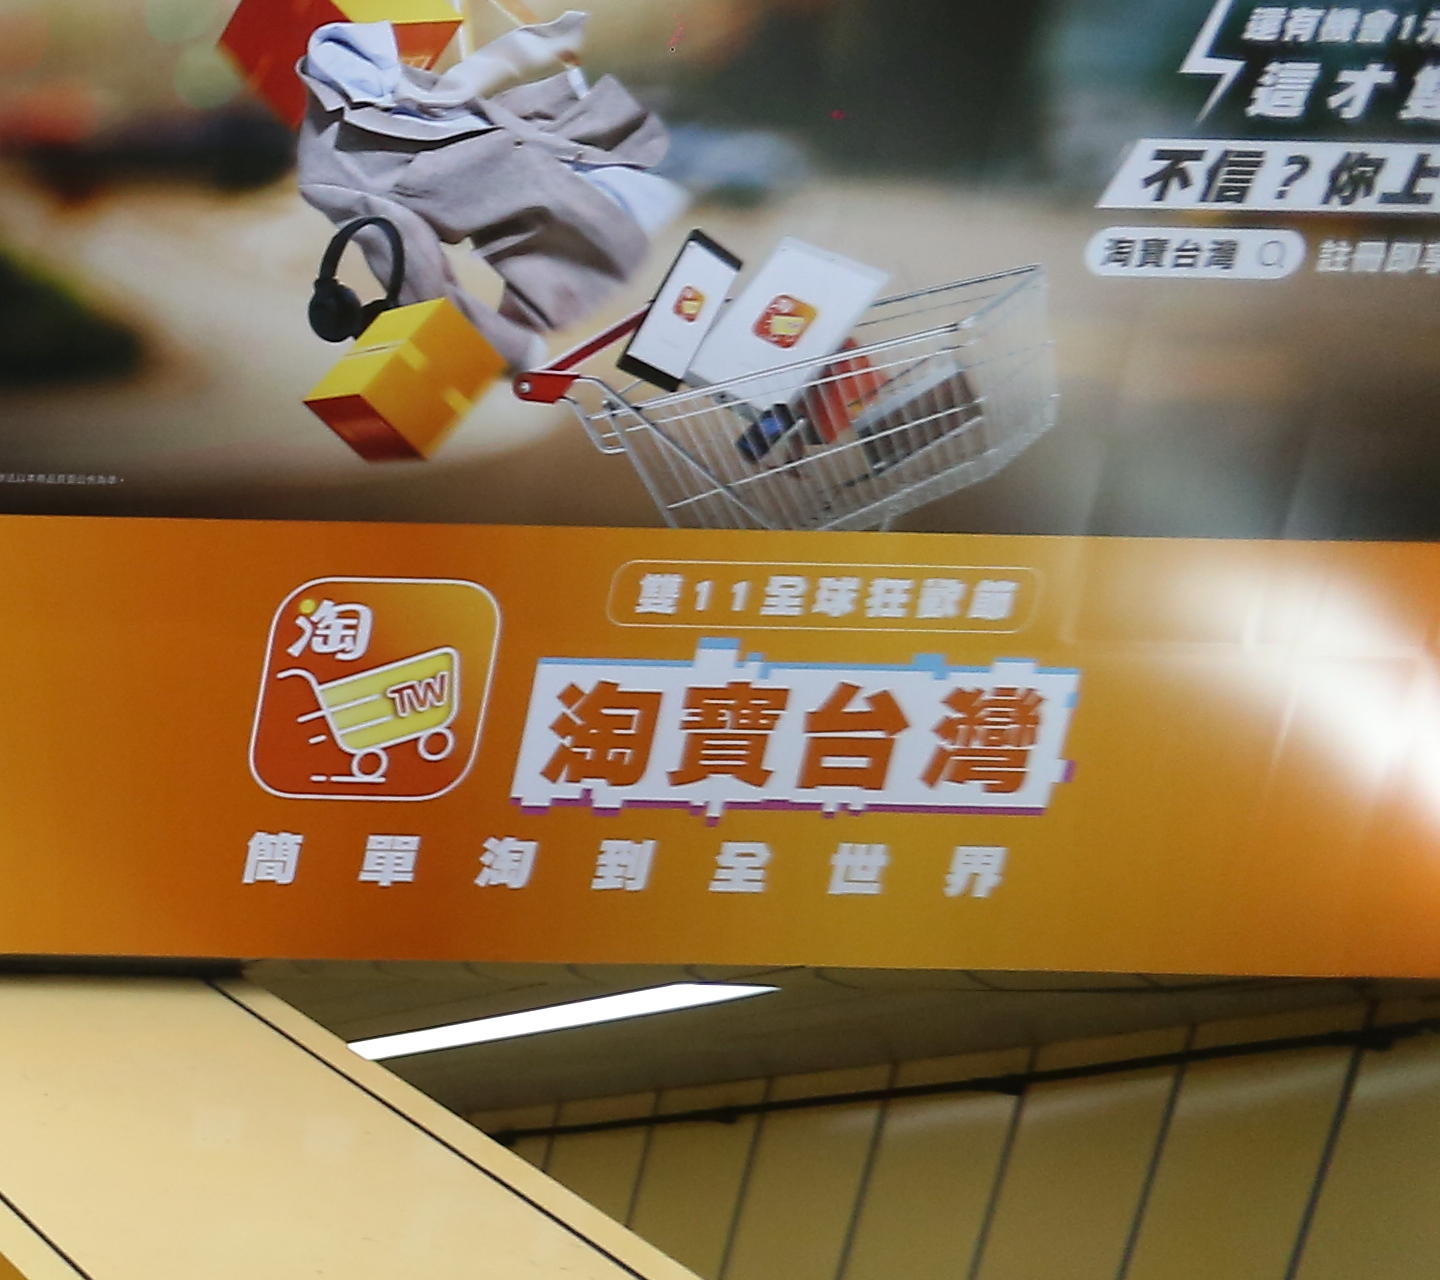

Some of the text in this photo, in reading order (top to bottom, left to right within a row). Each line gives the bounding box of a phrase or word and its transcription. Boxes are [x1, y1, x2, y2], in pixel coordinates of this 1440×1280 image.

[1101, 237, 1238, 269] 淘寶台灣
[635, 573, 1020, 622] 雙11全球狂歡節
[288, 600, 372, 661] 淘
[385, 672, 447, 717] TW
[539, 680, 1046, 794] 淘寶台灣
[242, 831, 1007, 899] 簡單淘到全世界
